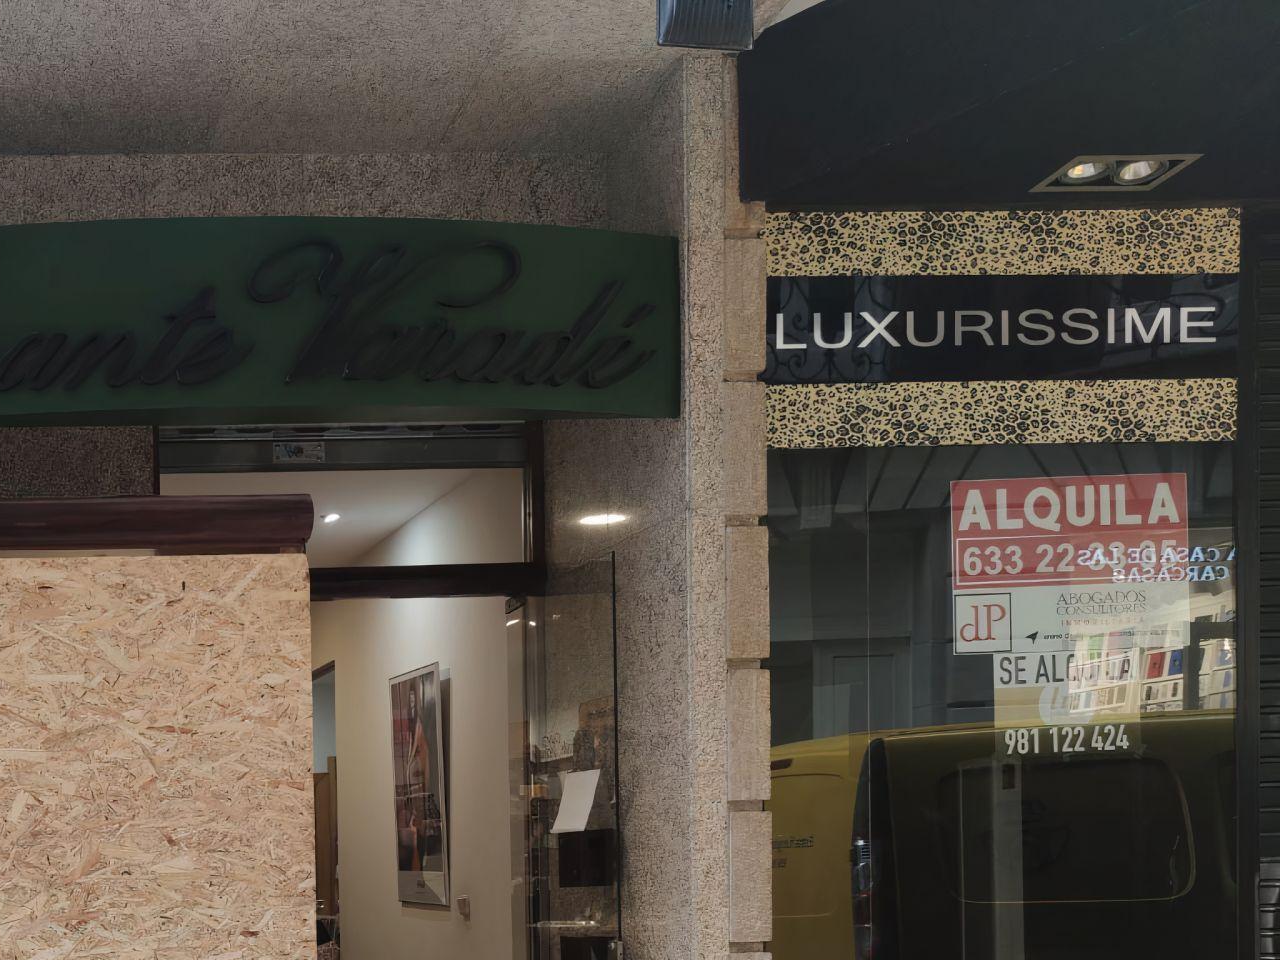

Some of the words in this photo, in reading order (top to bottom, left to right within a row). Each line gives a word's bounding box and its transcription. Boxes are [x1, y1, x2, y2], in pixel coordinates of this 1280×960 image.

[774, 305, 1218, 351] LUXURISSIME
[958, 482, 1181, 532] ALQUILA
[963, 545, 1024, 576] 633
[1035, 542, 1076, 574] 22
[1056, 590, 1147, 606] ABOGADOS
[999, 656, 1027, 685] SE
[1004, 728, 1040, 755] 981
[1050, 726, 1085, 753] 122
[1091, 724, 1130, 751] 424
